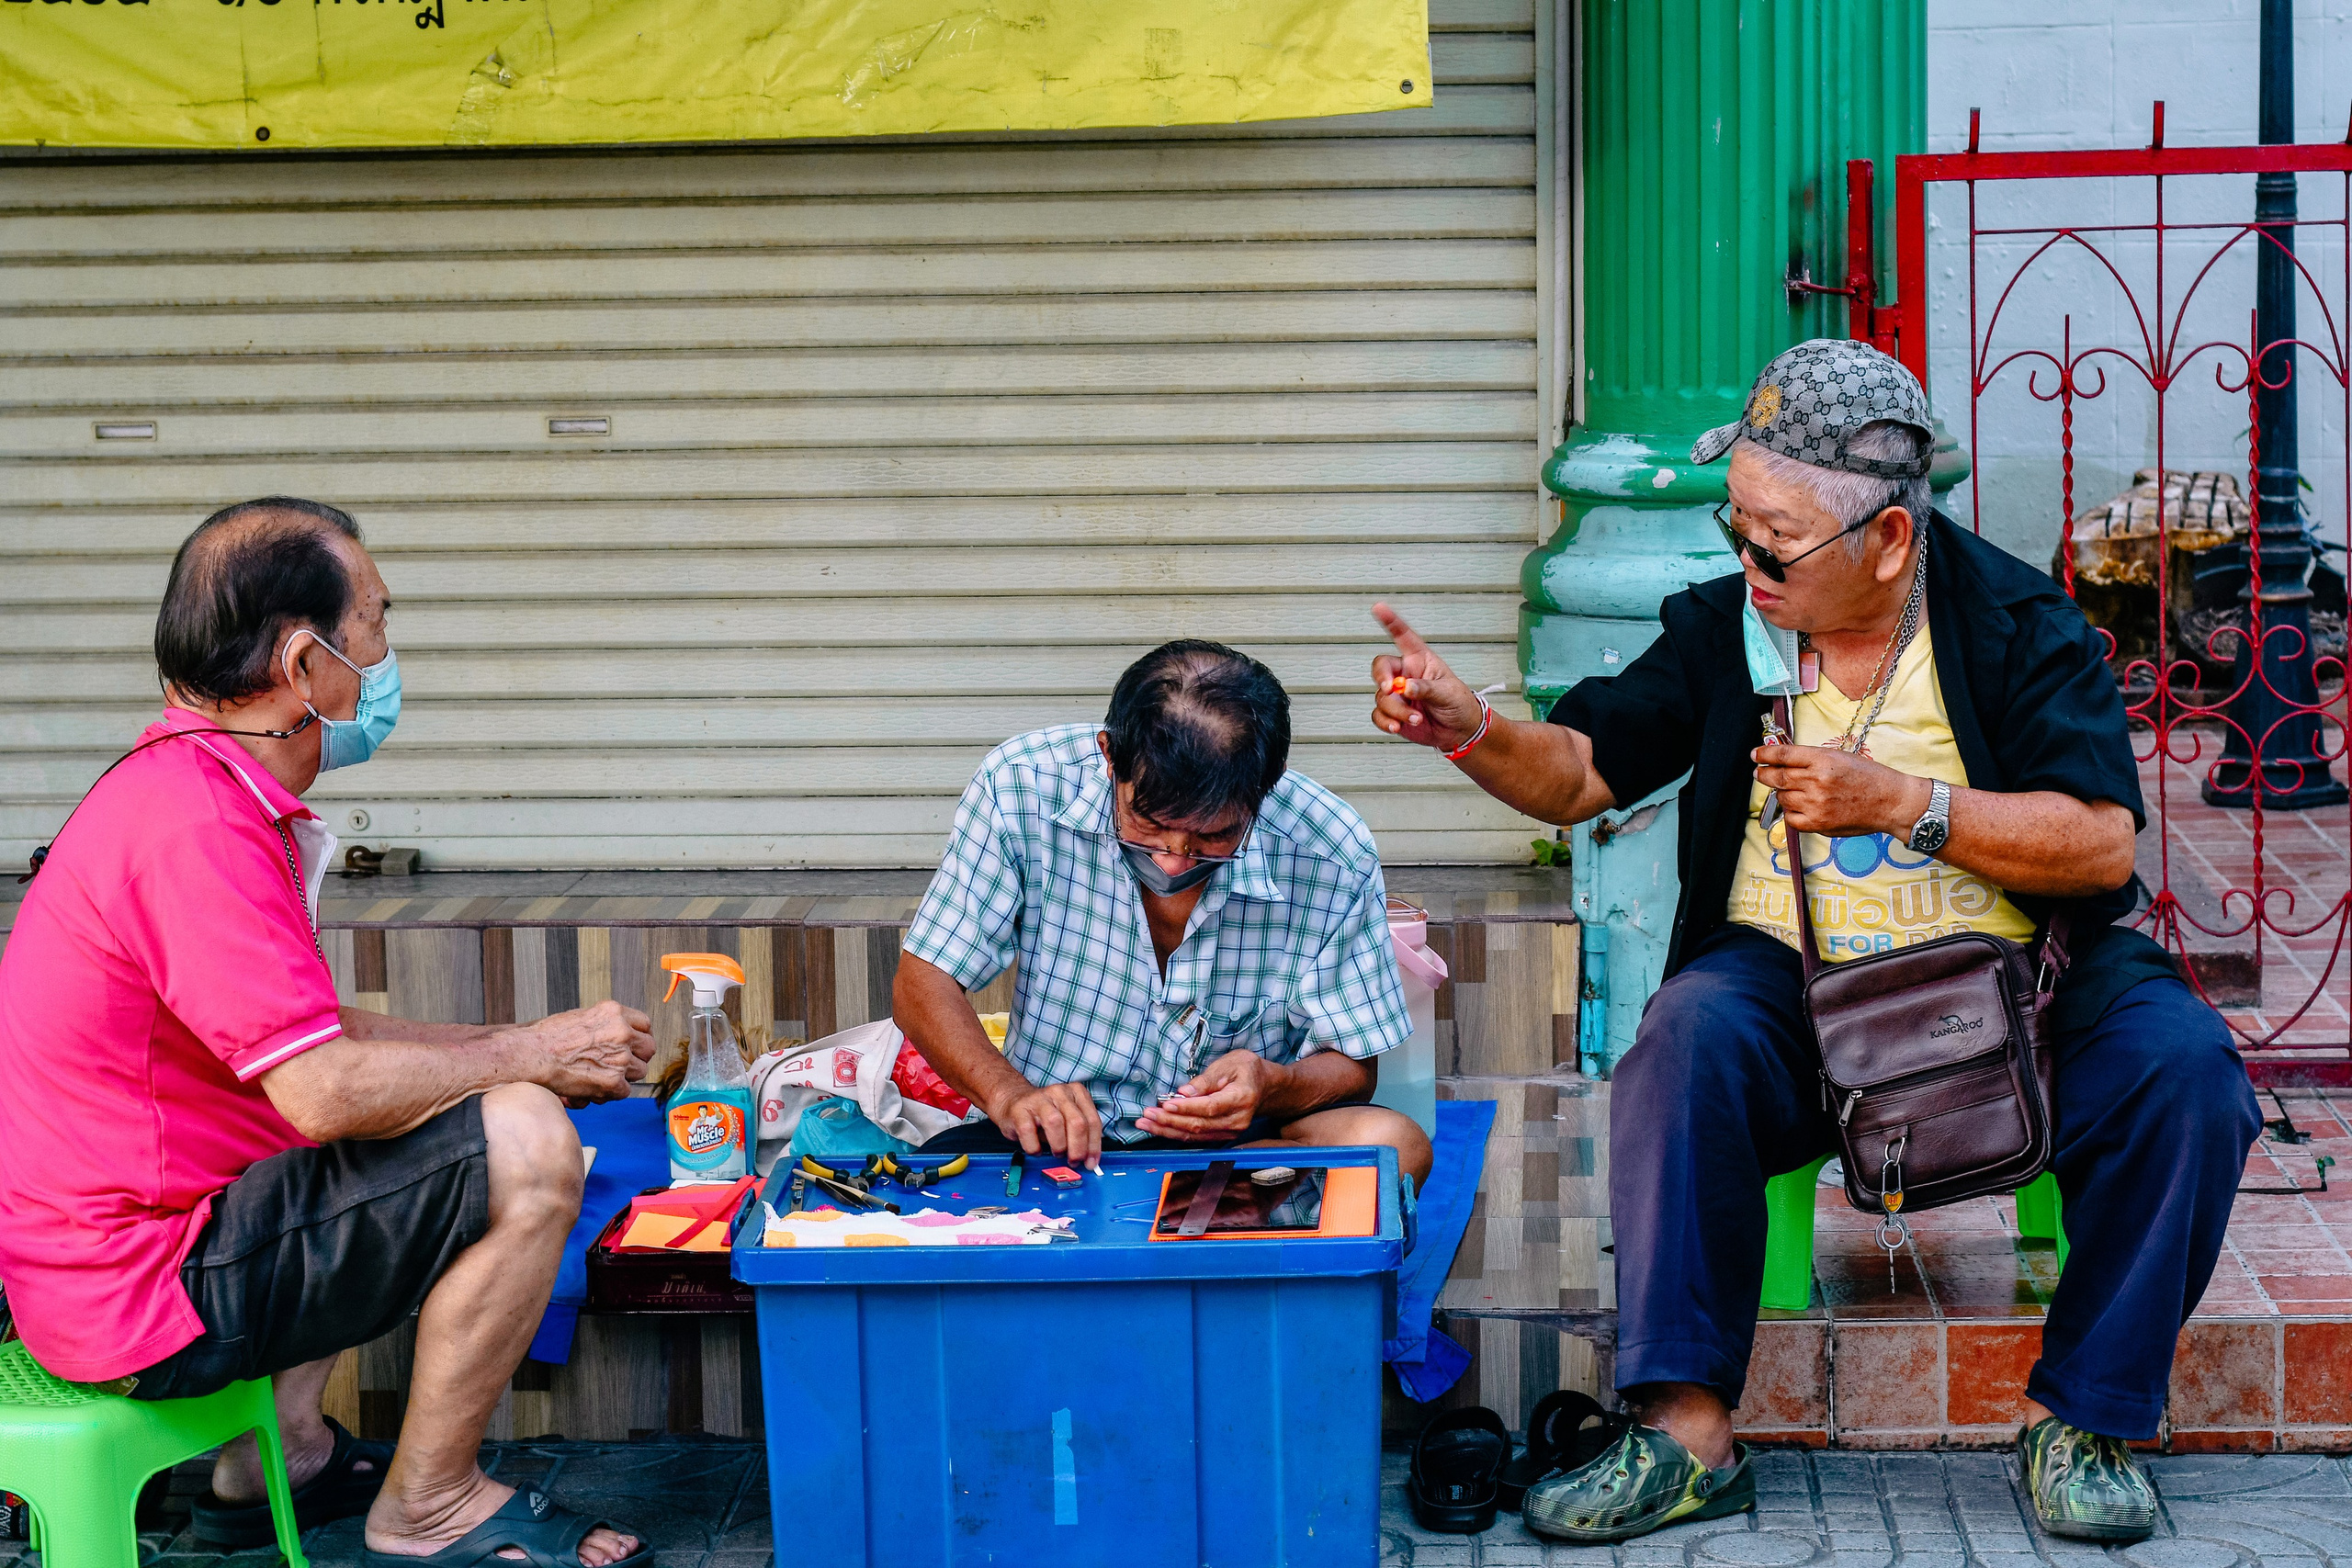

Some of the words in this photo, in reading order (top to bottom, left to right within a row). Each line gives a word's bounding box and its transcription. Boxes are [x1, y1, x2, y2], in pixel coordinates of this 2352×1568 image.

[1740, 868, 1998, 931] ปั่นพื่อพ่อ
[1827, 933, 1894, 953] FOR
[1930, 1020, 1983, 1039] KANGAROO
